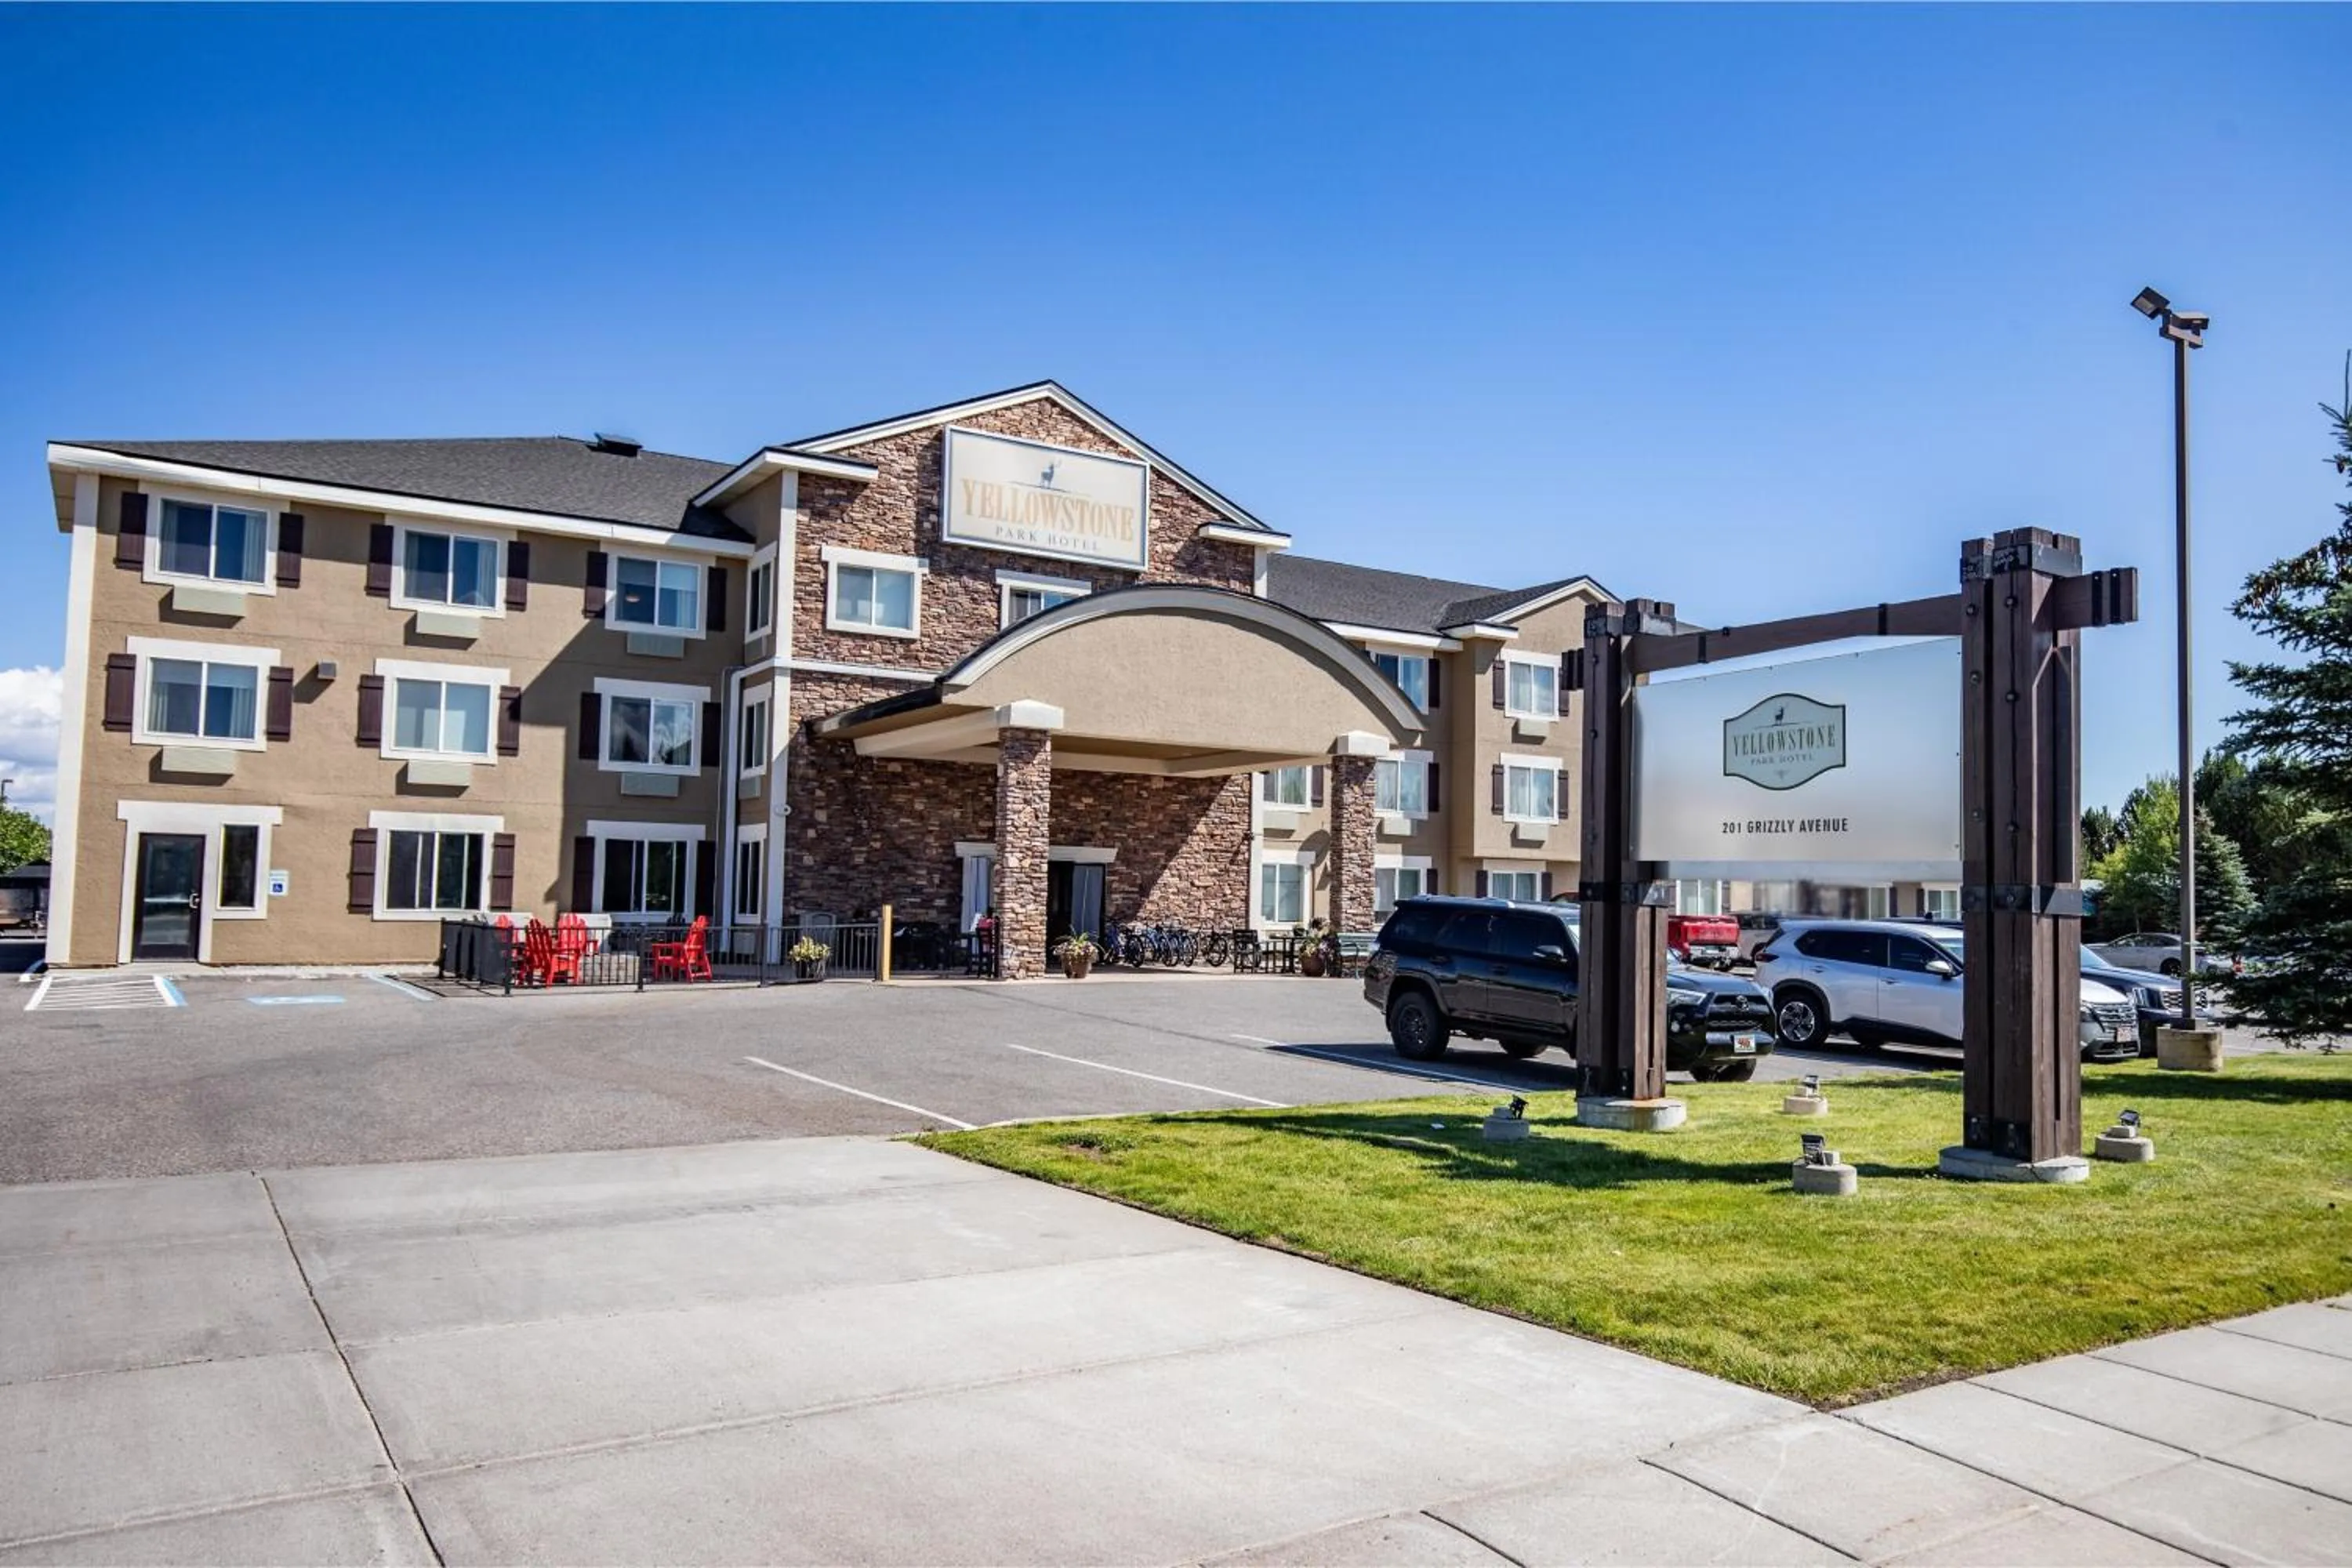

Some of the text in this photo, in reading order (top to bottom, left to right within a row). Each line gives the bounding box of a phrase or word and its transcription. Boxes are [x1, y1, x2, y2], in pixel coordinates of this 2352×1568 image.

[962, 478, 1134, 542] YELLOWSTONE
[995, 525, 1100, 552] PARK HOTEL
[1732, 724, 1835, 757] YELLOWSTONE
[1722, 818, 1849, 833] 201 GRIZZLY AVENUE
